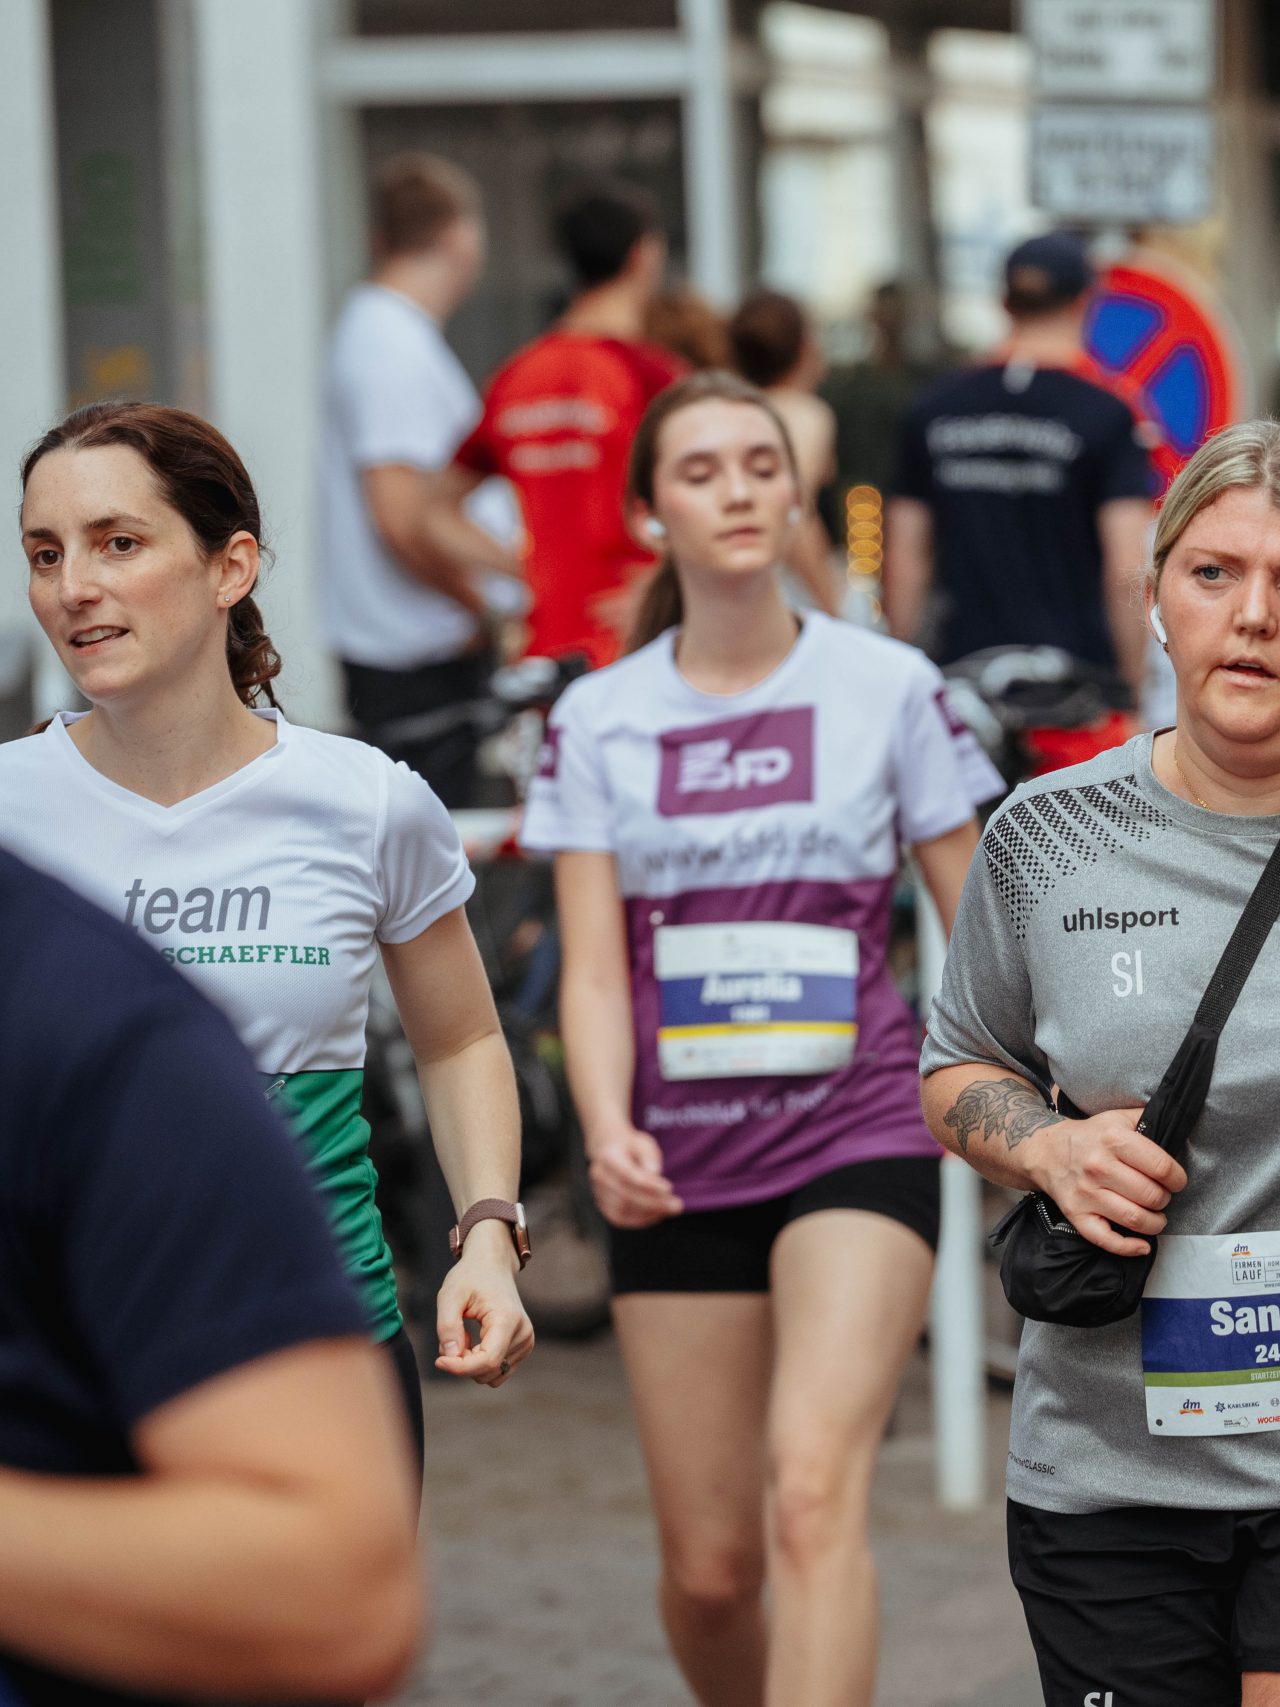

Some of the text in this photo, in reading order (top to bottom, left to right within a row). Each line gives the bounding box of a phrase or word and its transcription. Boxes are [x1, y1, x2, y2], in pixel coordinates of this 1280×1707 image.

[123, 878, 271, 935] team
[1062, 906, 1180, 933] uhlsport
[160, 944, 331, 966] SCHAEFFLER
[1110, 950, 1144, 998] SI
[1233, 1243, 1249, 1253] dm
[1234, 1260, 1262, 1269] FIRMEN
[1235, 1269, 1262, 1281] LAUF
[1250, 1369, 1280, 1380] STARTZEIT
[1182, 1399, 1201, 1410] dm
[1227, 1401, 1260, 1410] KARLSBERG
